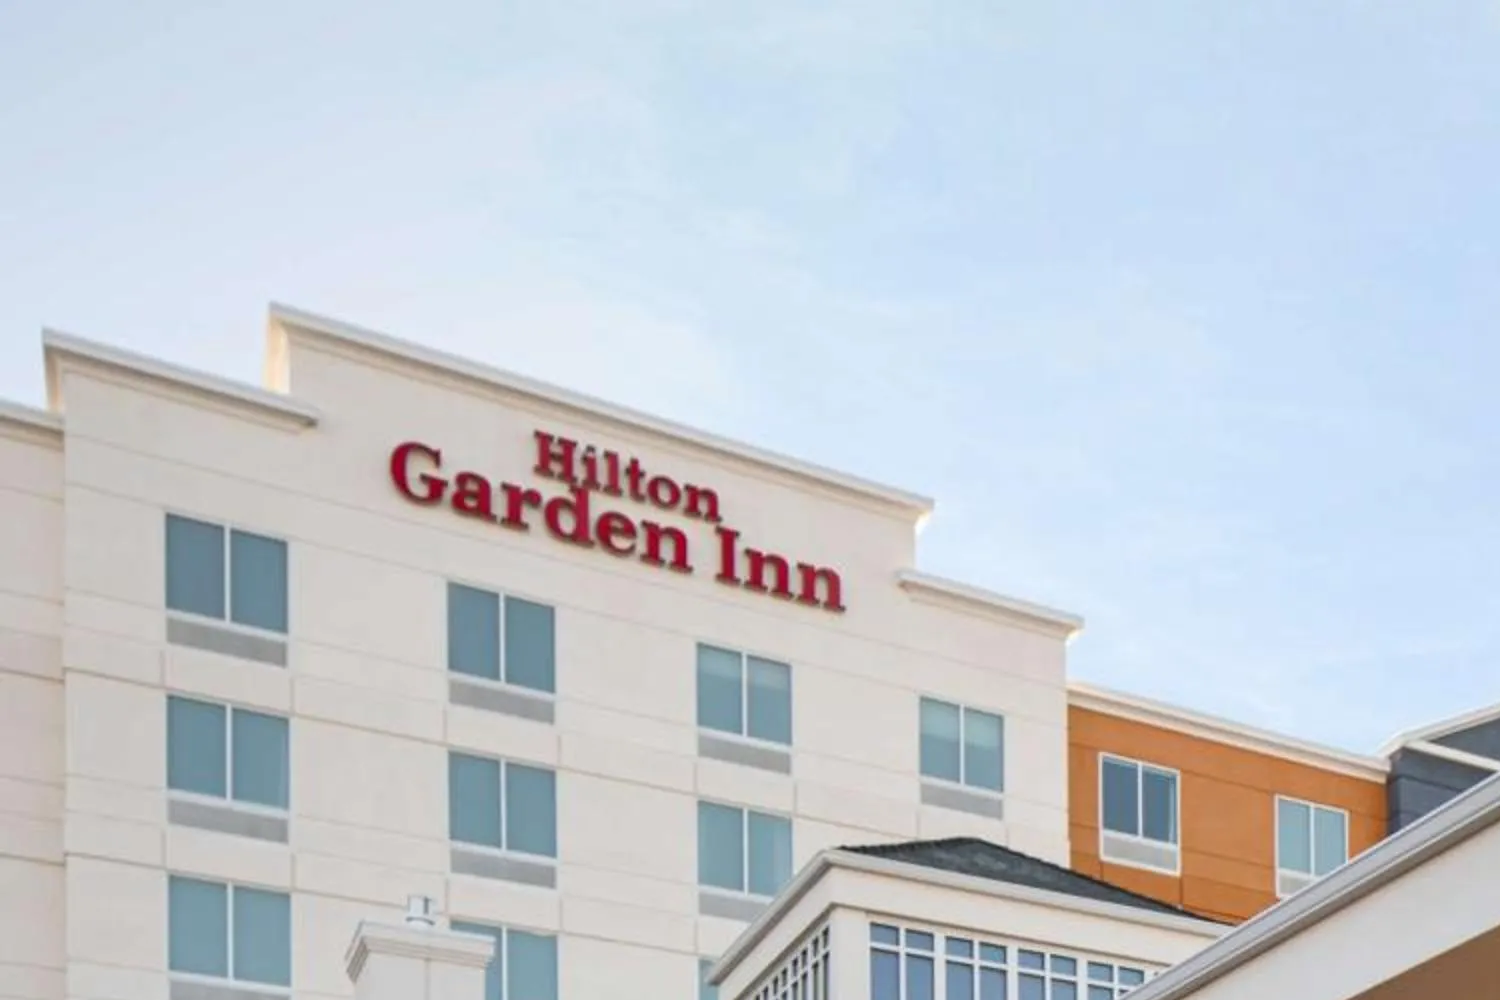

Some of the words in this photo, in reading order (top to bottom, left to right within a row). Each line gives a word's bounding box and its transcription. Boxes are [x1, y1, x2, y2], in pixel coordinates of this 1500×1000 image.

[390, 441, 694, 573] Garden
[715, 524, 846, 613] Inn
[533, 430, 722, 523] Hilton
